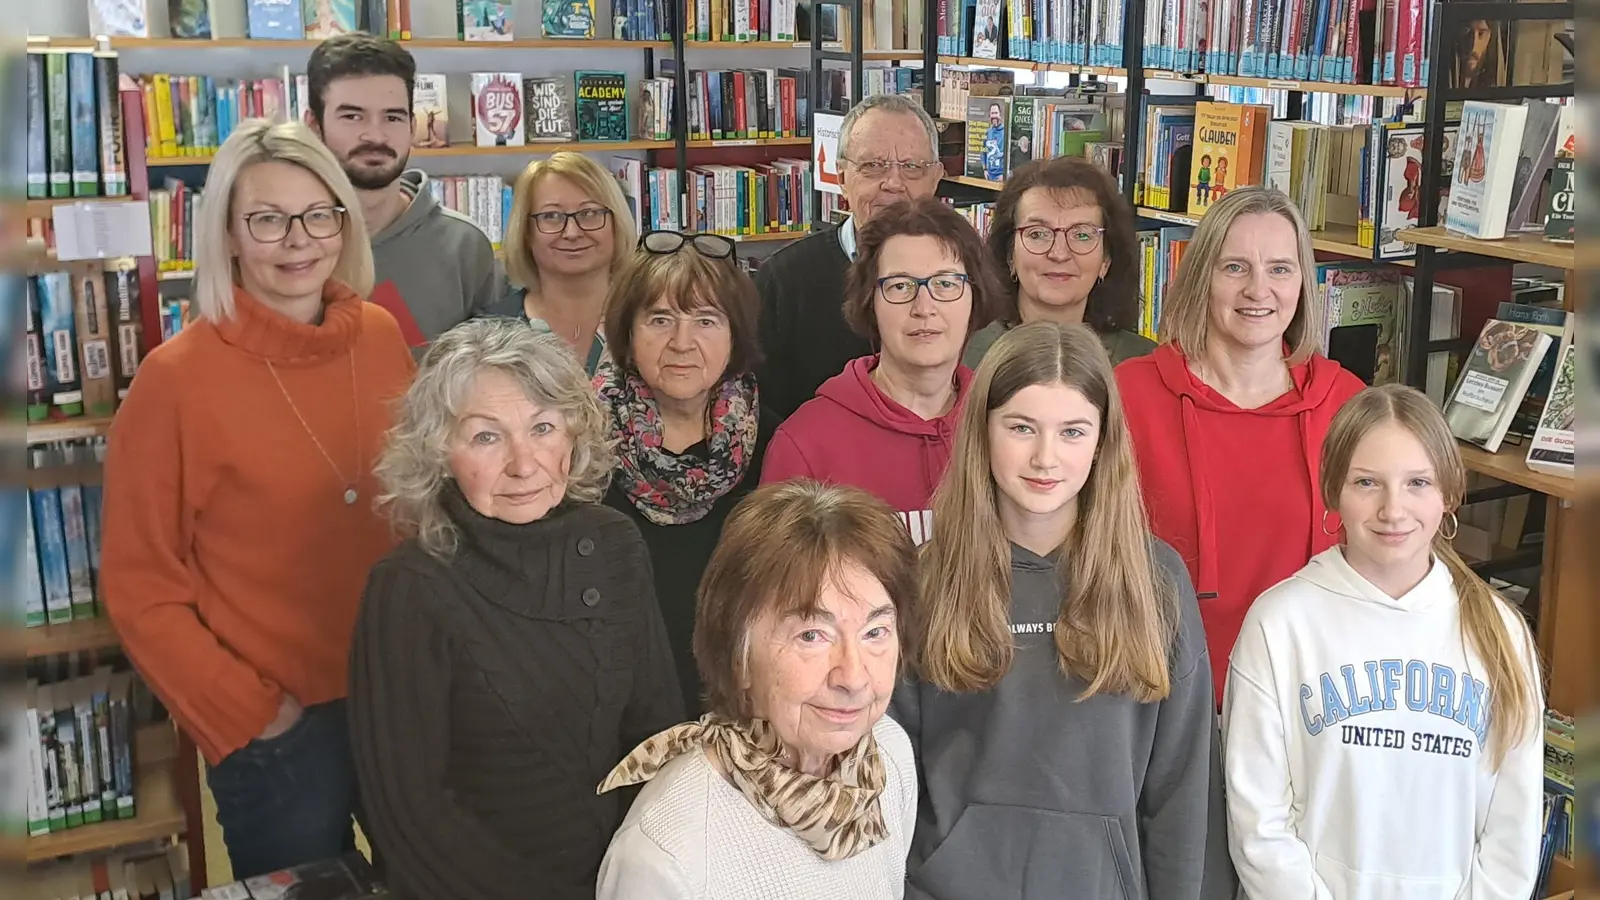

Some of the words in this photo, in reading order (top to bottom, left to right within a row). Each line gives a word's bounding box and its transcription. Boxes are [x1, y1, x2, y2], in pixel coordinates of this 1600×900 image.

[532, 83, 556, 98] WIR
[578, 86, 626, 99] ACADEMY
[486, 92, 514, 109] BUS
[532, 95, 560, 109] SIND
[538, 107, 557, 121] DIE
[1017, 106, 1032, 115] SAG
[487, 109, 516, 133] 57
[535, 119, 564, 134] FLUT
[1176, 133, 1191, 141] Gott
[1198, 126, 1237, 146] GLAUBEN
[1341, 725, 1405, 749] UNITED
[1411, 732, 1472, 758] STATES
